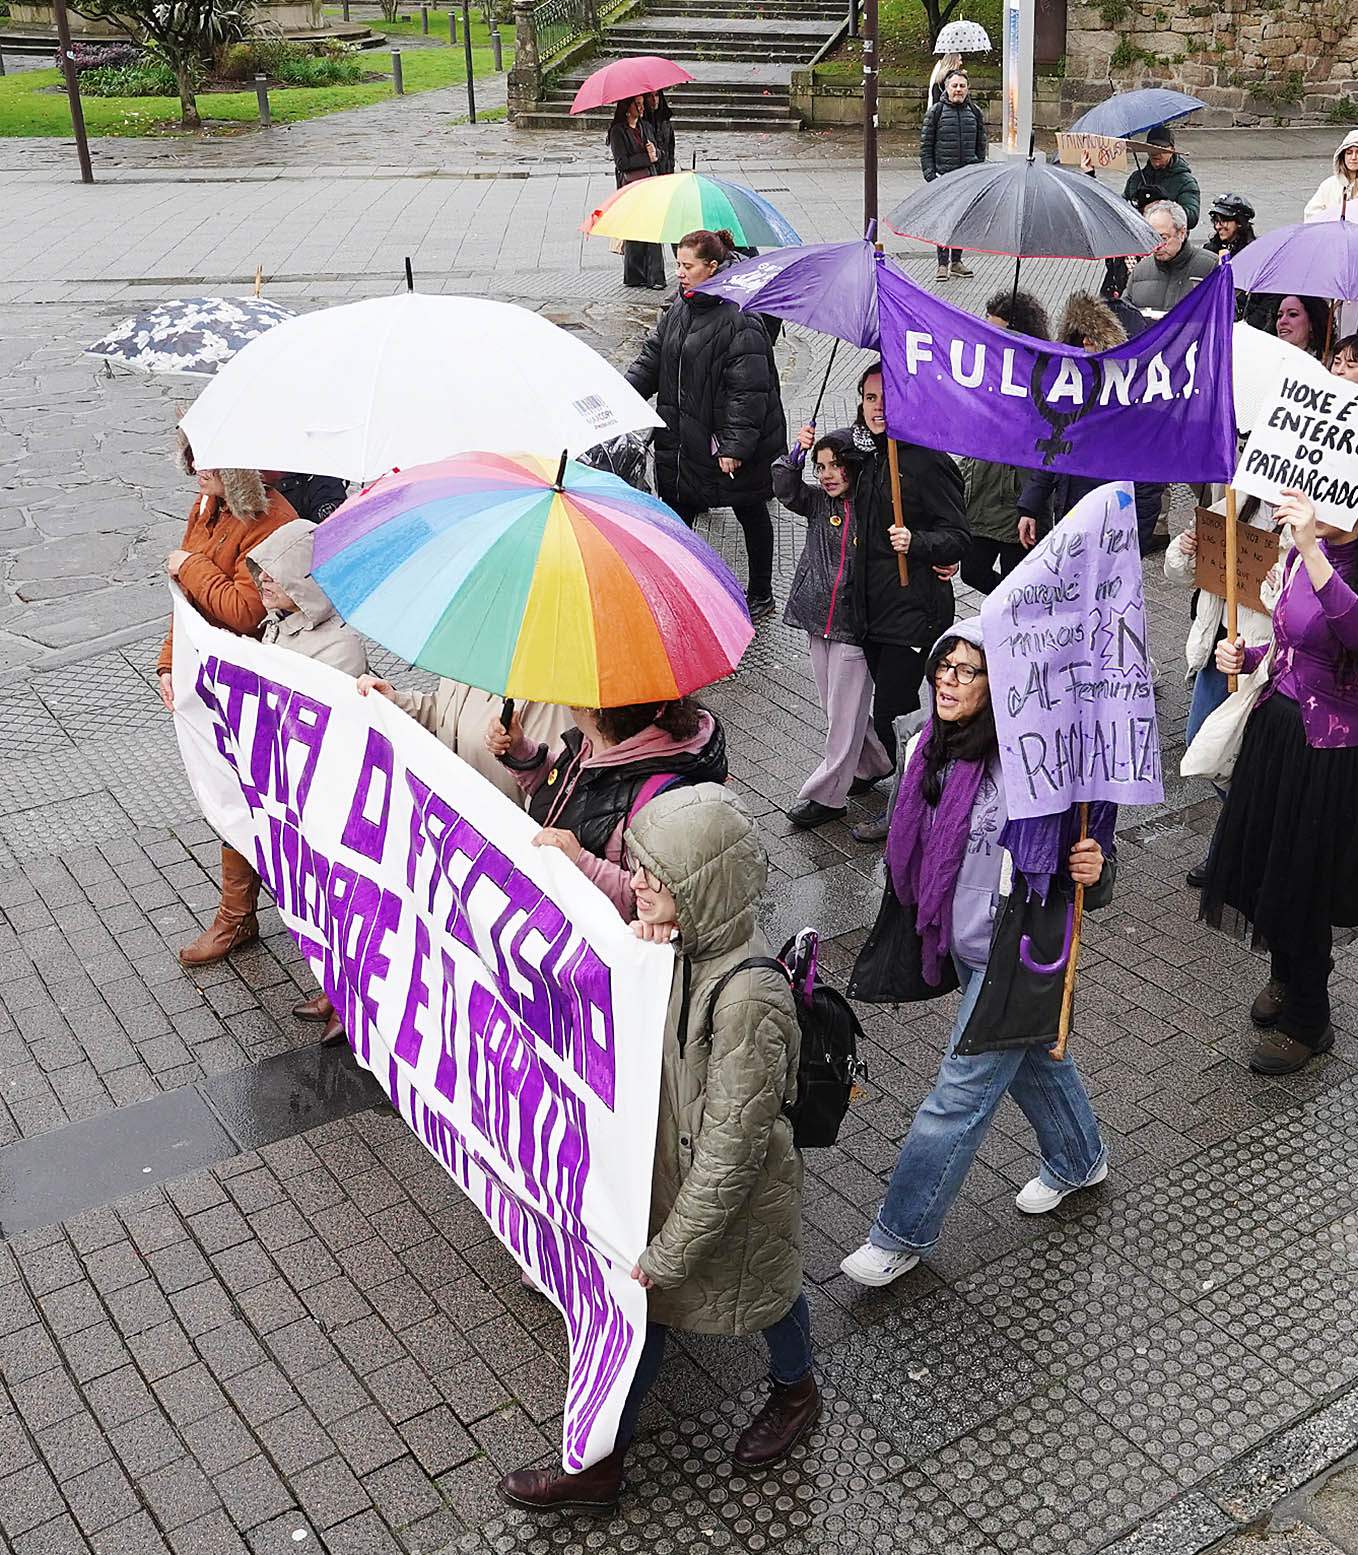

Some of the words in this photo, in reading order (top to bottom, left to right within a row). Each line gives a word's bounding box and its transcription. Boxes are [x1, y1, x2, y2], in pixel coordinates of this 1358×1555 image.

[1280, 377, 1337, 414] HOXE
[1294, 444, 1324, 465] DO
[341, 726, 395, 864] O
